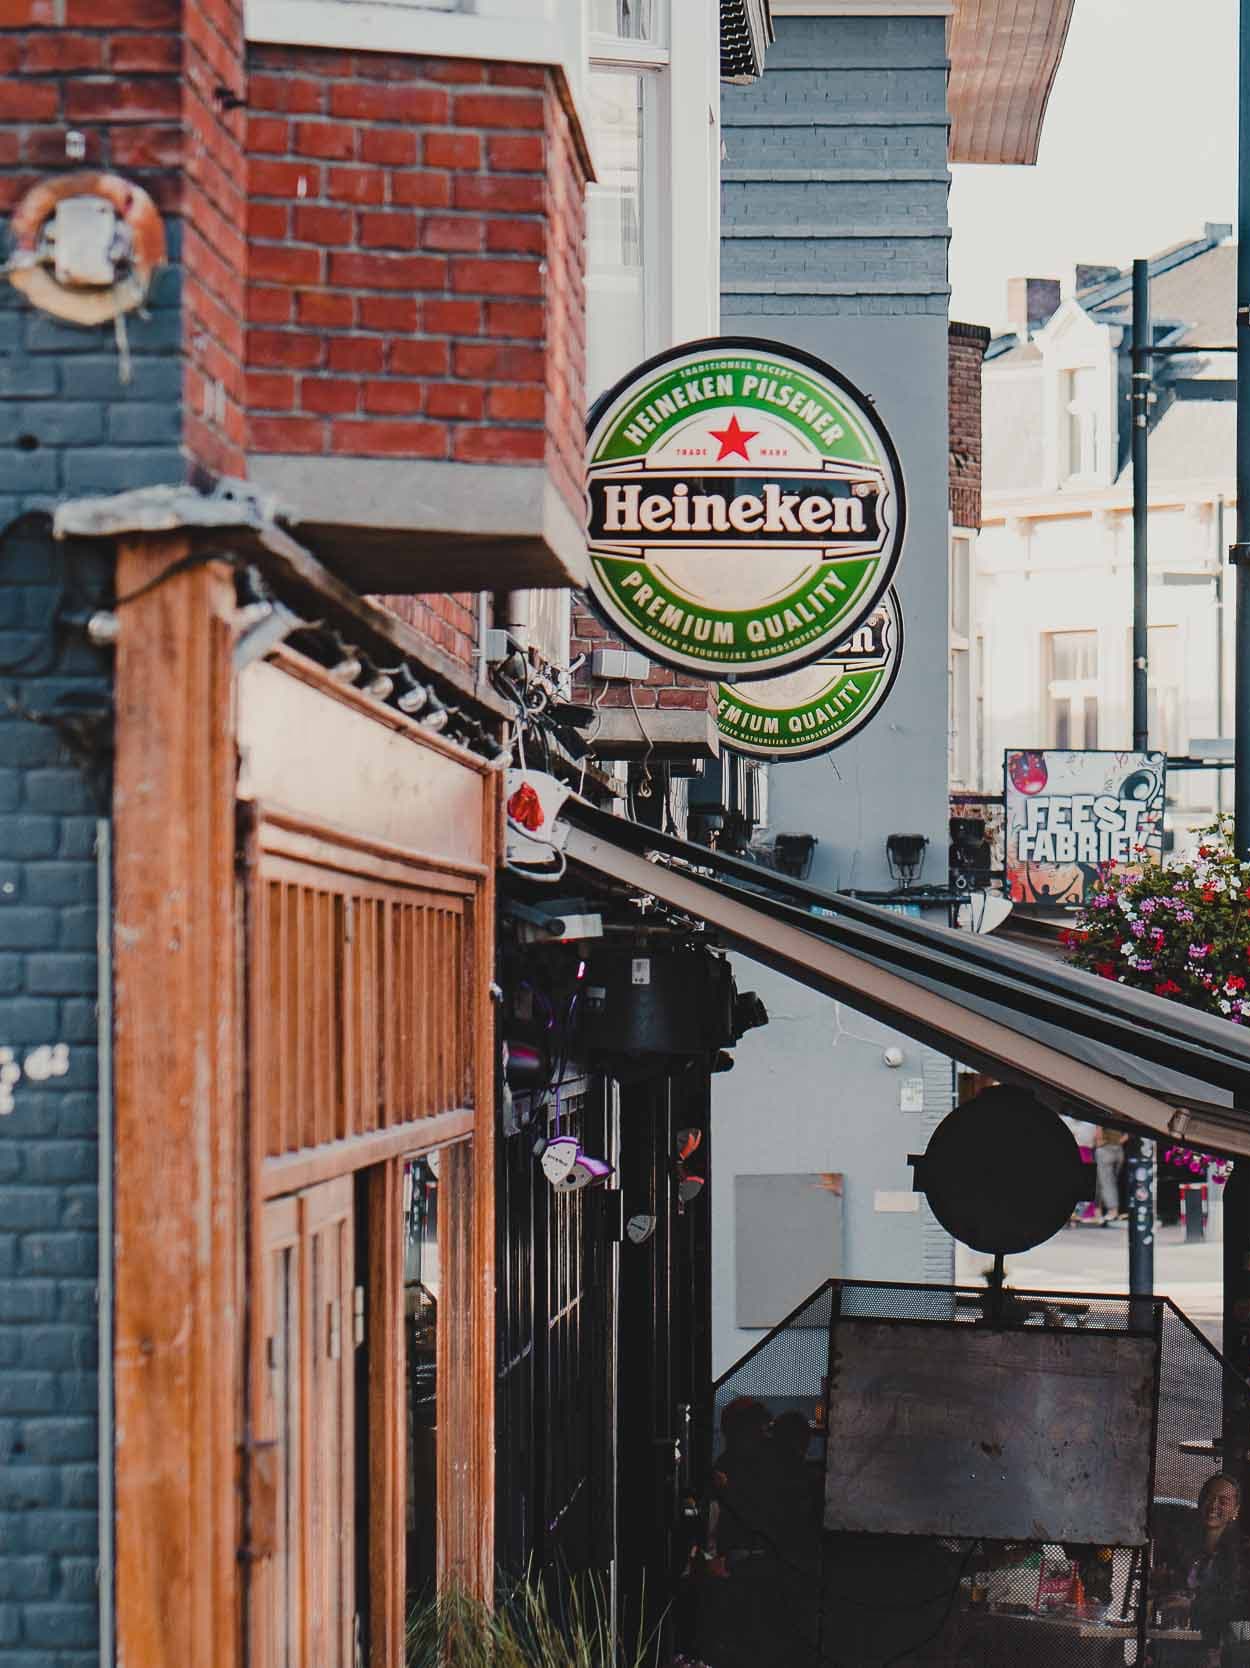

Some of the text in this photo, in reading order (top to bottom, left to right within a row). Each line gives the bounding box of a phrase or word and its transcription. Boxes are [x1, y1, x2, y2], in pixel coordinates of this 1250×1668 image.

[623, 374, 845, 446] HEINEKEN PILSENER
[602, 483, 867, 533] Heineken
[621, 570, 847, 644] PREMIUM QUALITY
[718, 680, 861, 734] EMIUM QUALITY
[1026, 794, 1147, 832] FEEST
